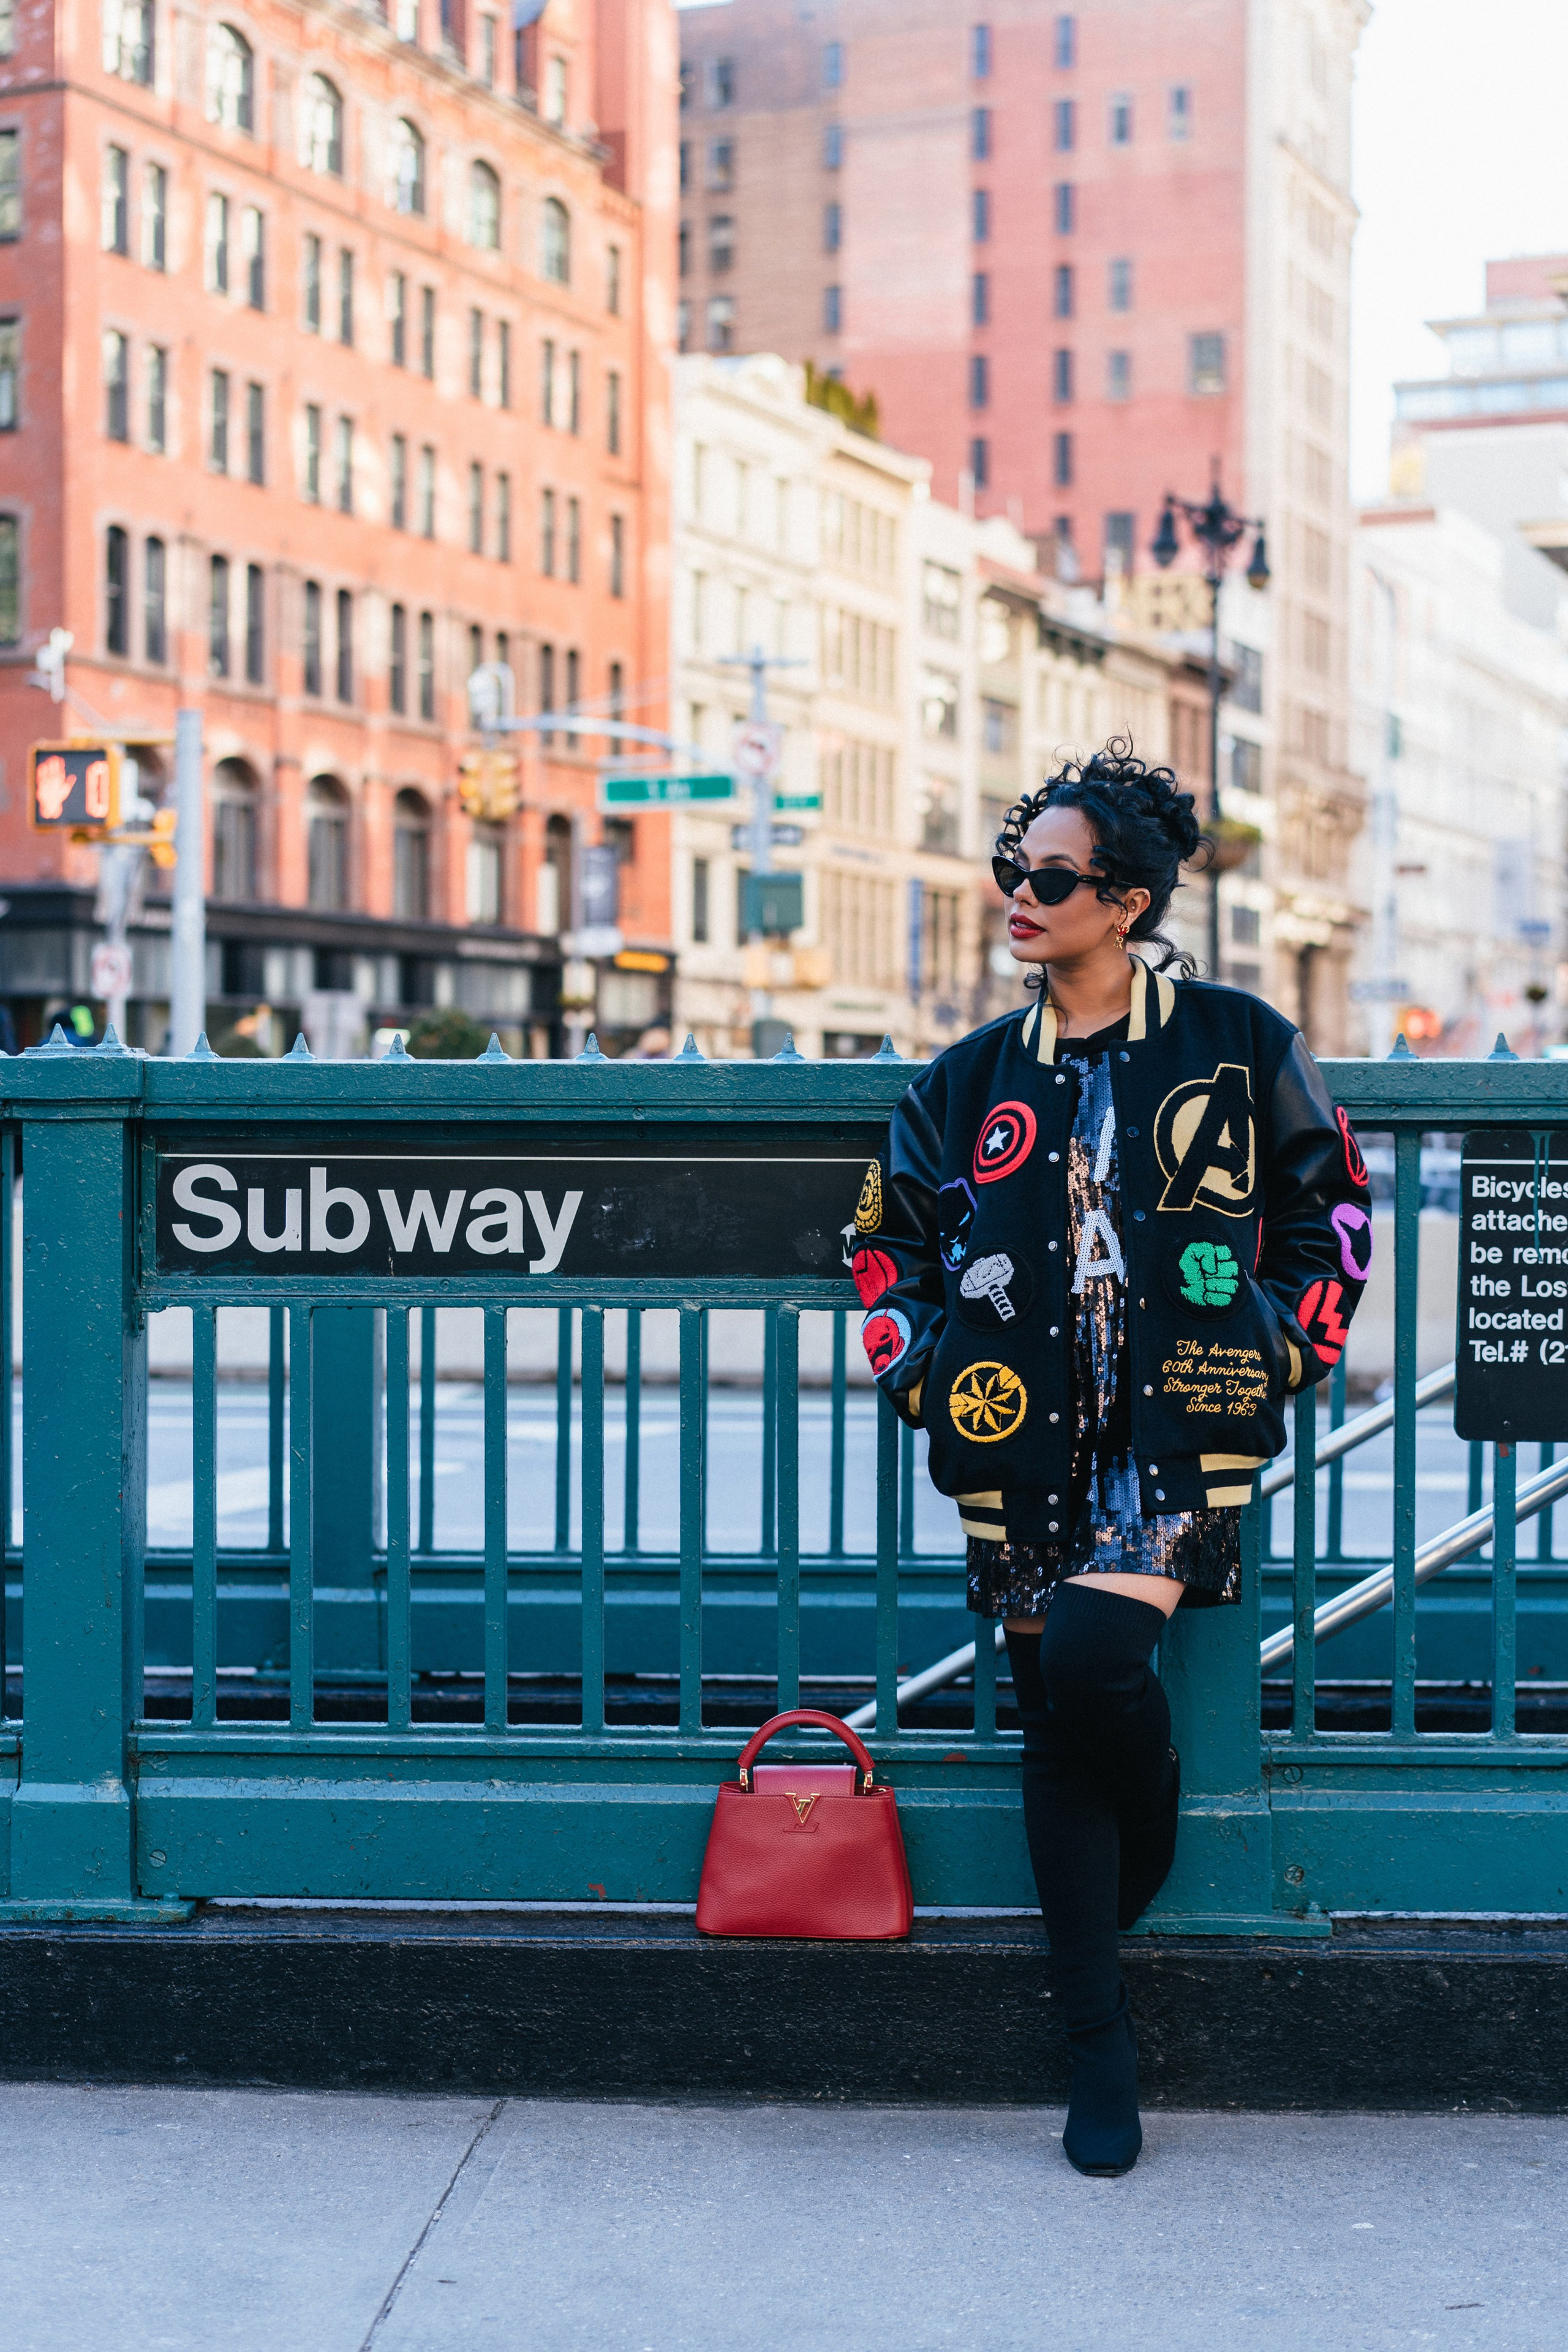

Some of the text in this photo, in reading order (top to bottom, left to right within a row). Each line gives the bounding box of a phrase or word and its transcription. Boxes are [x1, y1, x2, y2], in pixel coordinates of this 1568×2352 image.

[171, 1163, 583, 1275] Subway
[1471, 1242, 1502, 1264] be
[1470, 1275, 1568, 1298] the Los
[1469, 1307, 1564, 1330] located
[1177, 1340, 1262, 1365] The Avengers
[1469, 1340, 1529, 1363] Tel.#
[1162, 1358, 1269, 1387] 60th Anniversary
[1164, 1377, 1222, 1401] Stronger
[1186, 1396, 1257, 1417] Since 1963
